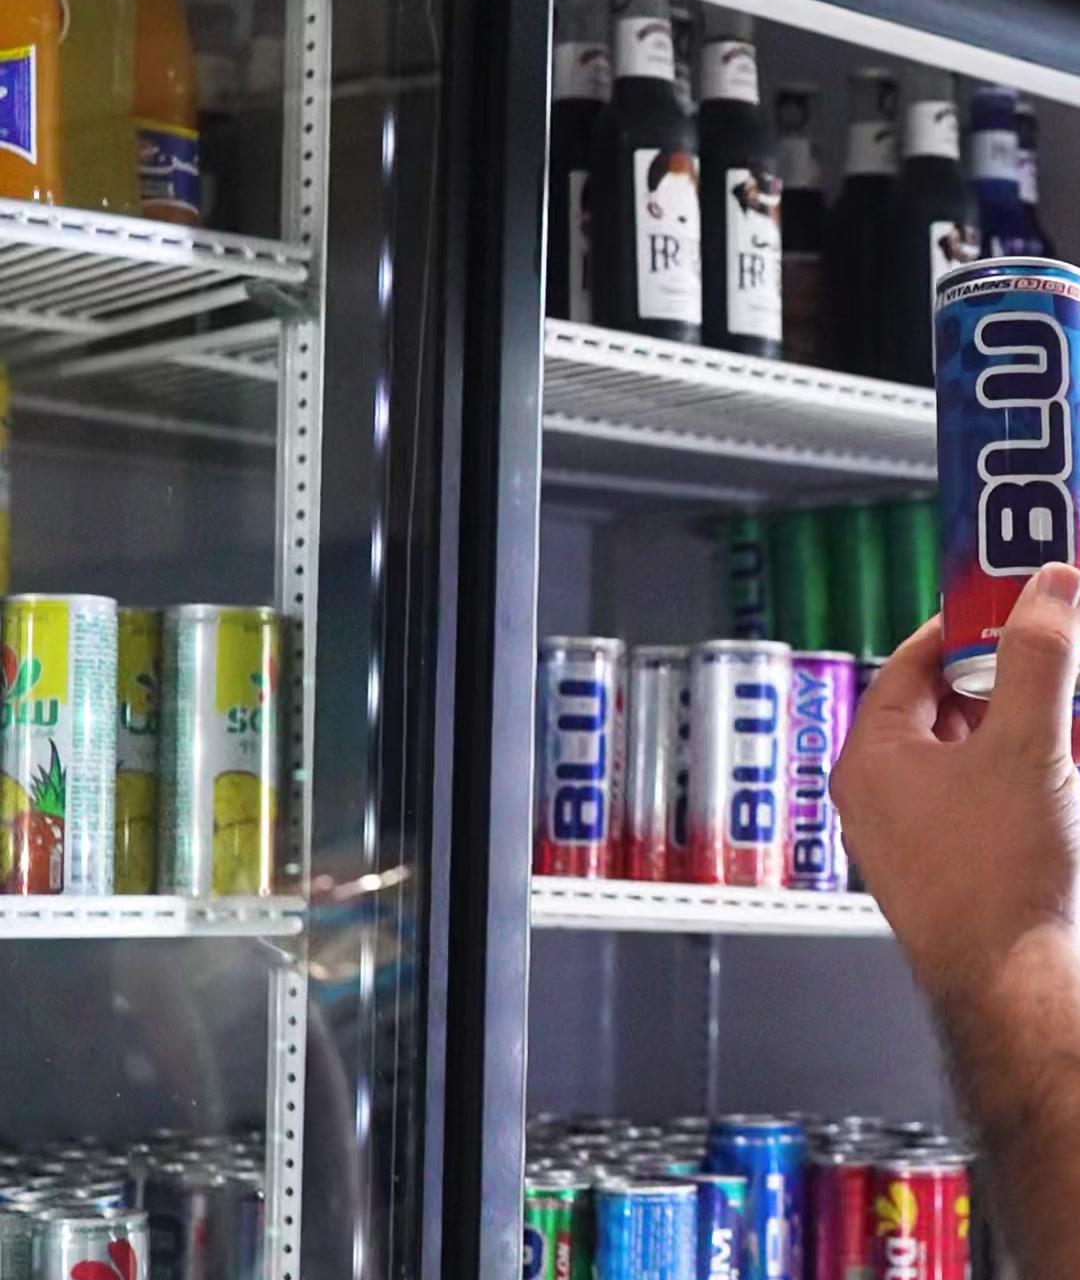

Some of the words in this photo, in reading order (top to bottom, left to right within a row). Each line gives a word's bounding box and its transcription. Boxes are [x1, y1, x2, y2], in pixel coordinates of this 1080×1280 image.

[946, 278, 1012, 301] VITAMINS
[974, 311, 1075, 576] BLU
[552, 678, 607, 844] BLU
[729, 682, 779, 844] BLU
